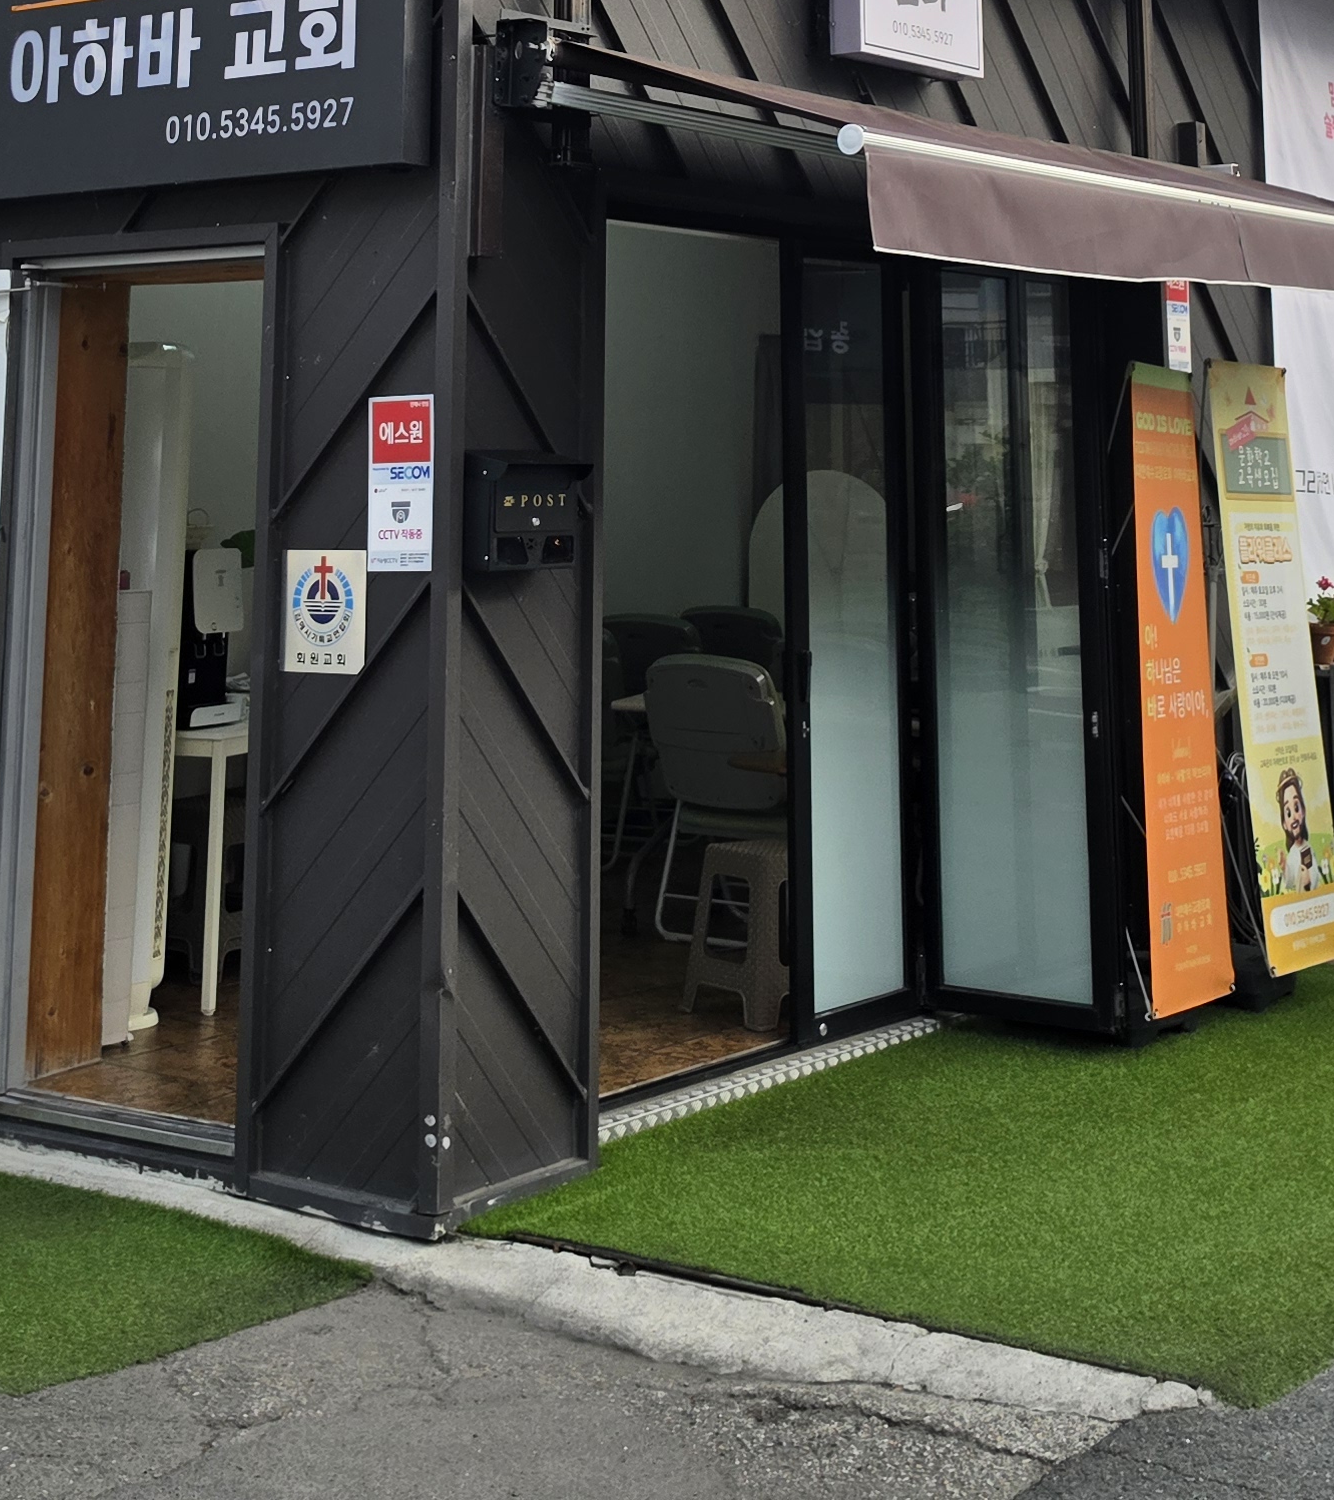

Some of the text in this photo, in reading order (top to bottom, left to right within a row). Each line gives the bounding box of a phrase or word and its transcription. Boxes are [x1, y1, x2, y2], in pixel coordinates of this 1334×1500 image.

[10, 7, 201, 104] 아하바
[165, 97, 355, 144] 010.5345.5927
[378, 420, 424, 445] 에스원
[1136, 411, 1193, 436] GOD IS LOVE
[390, 465, 430, 480] SECOM
[520, 493, 566, 507] POST
[378, 529, 400, 540] CCTV
[1238, 536, 1293, 564] 플라워클래스
[1144, 624, 1158, 650] 아!
[1145, 657, 1182, 686] 하나님은
[1147, 694, 1166, 722] 바로
